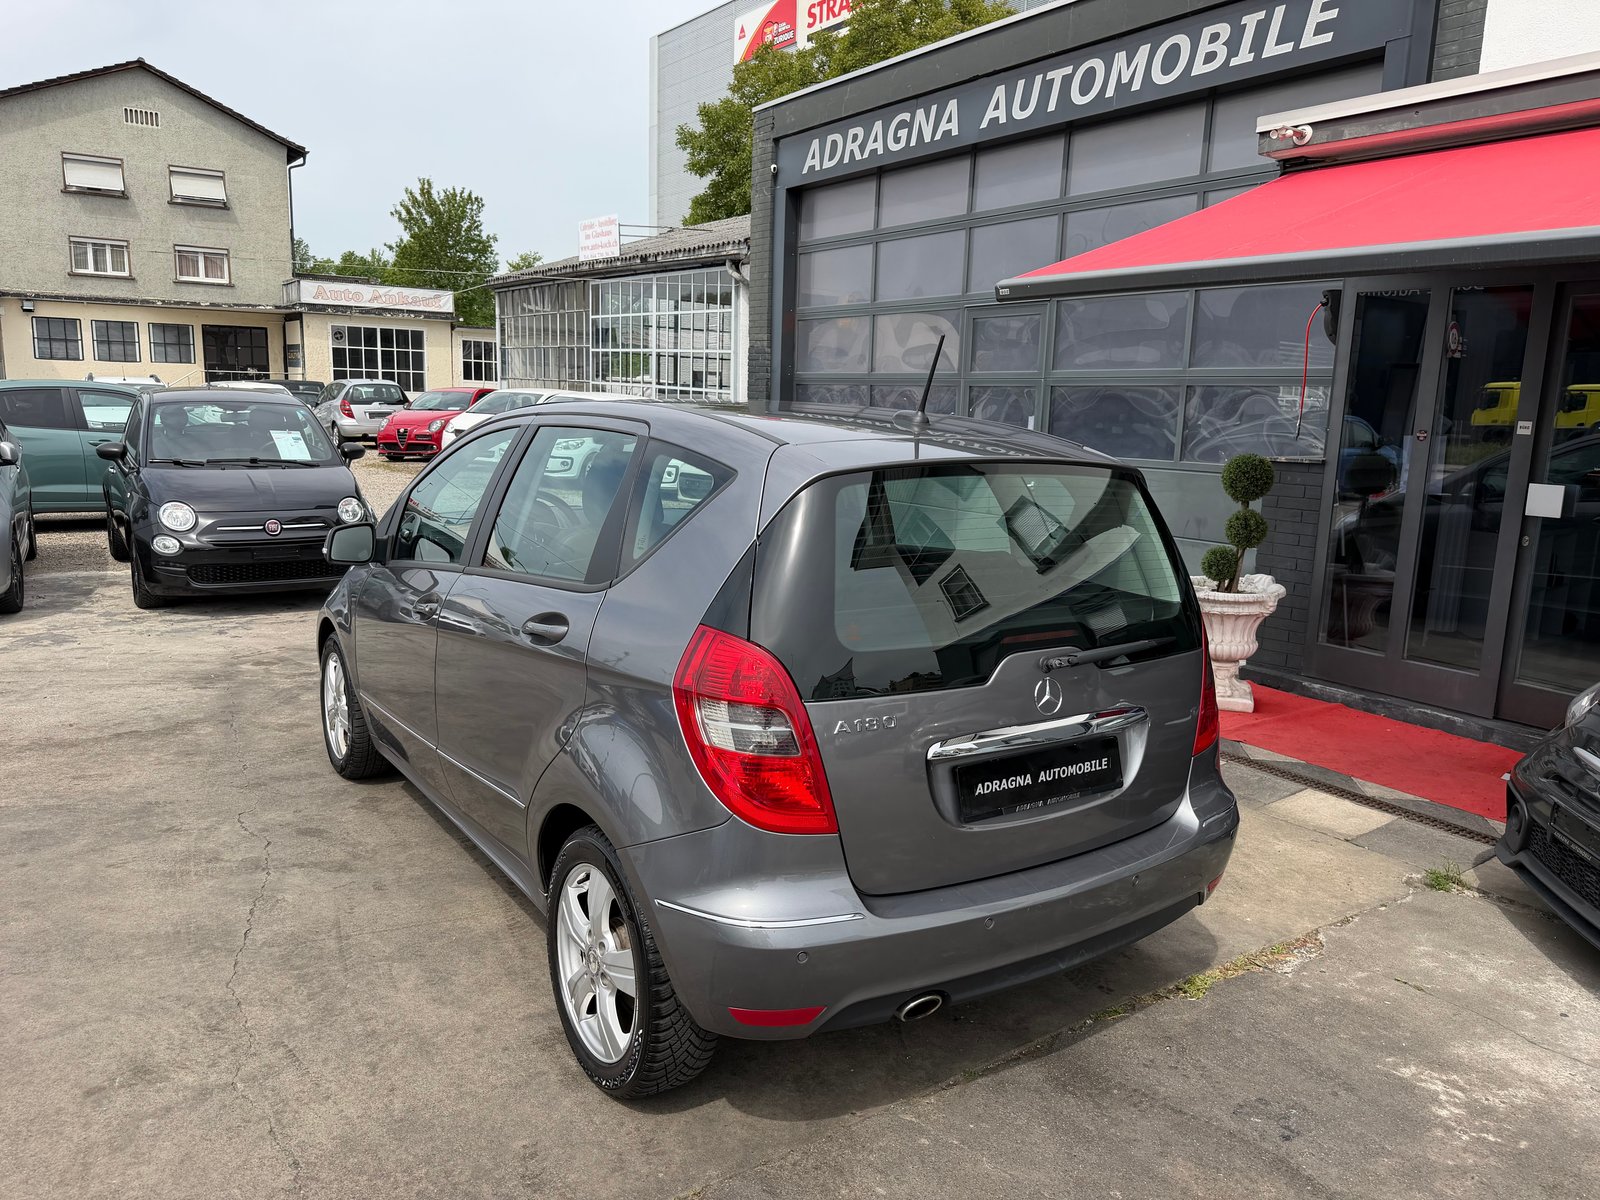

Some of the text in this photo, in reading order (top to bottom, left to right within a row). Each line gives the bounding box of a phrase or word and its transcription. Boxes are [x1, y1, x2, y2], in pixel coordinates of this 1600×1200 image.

[801, 0, 1340, 174] ADRAGNA AUTOMOBILE
[313, 284, 443, 308] Auto Ankauf
[975, 757, 1108, 796] ADRAGNA AUTOMOBILE
